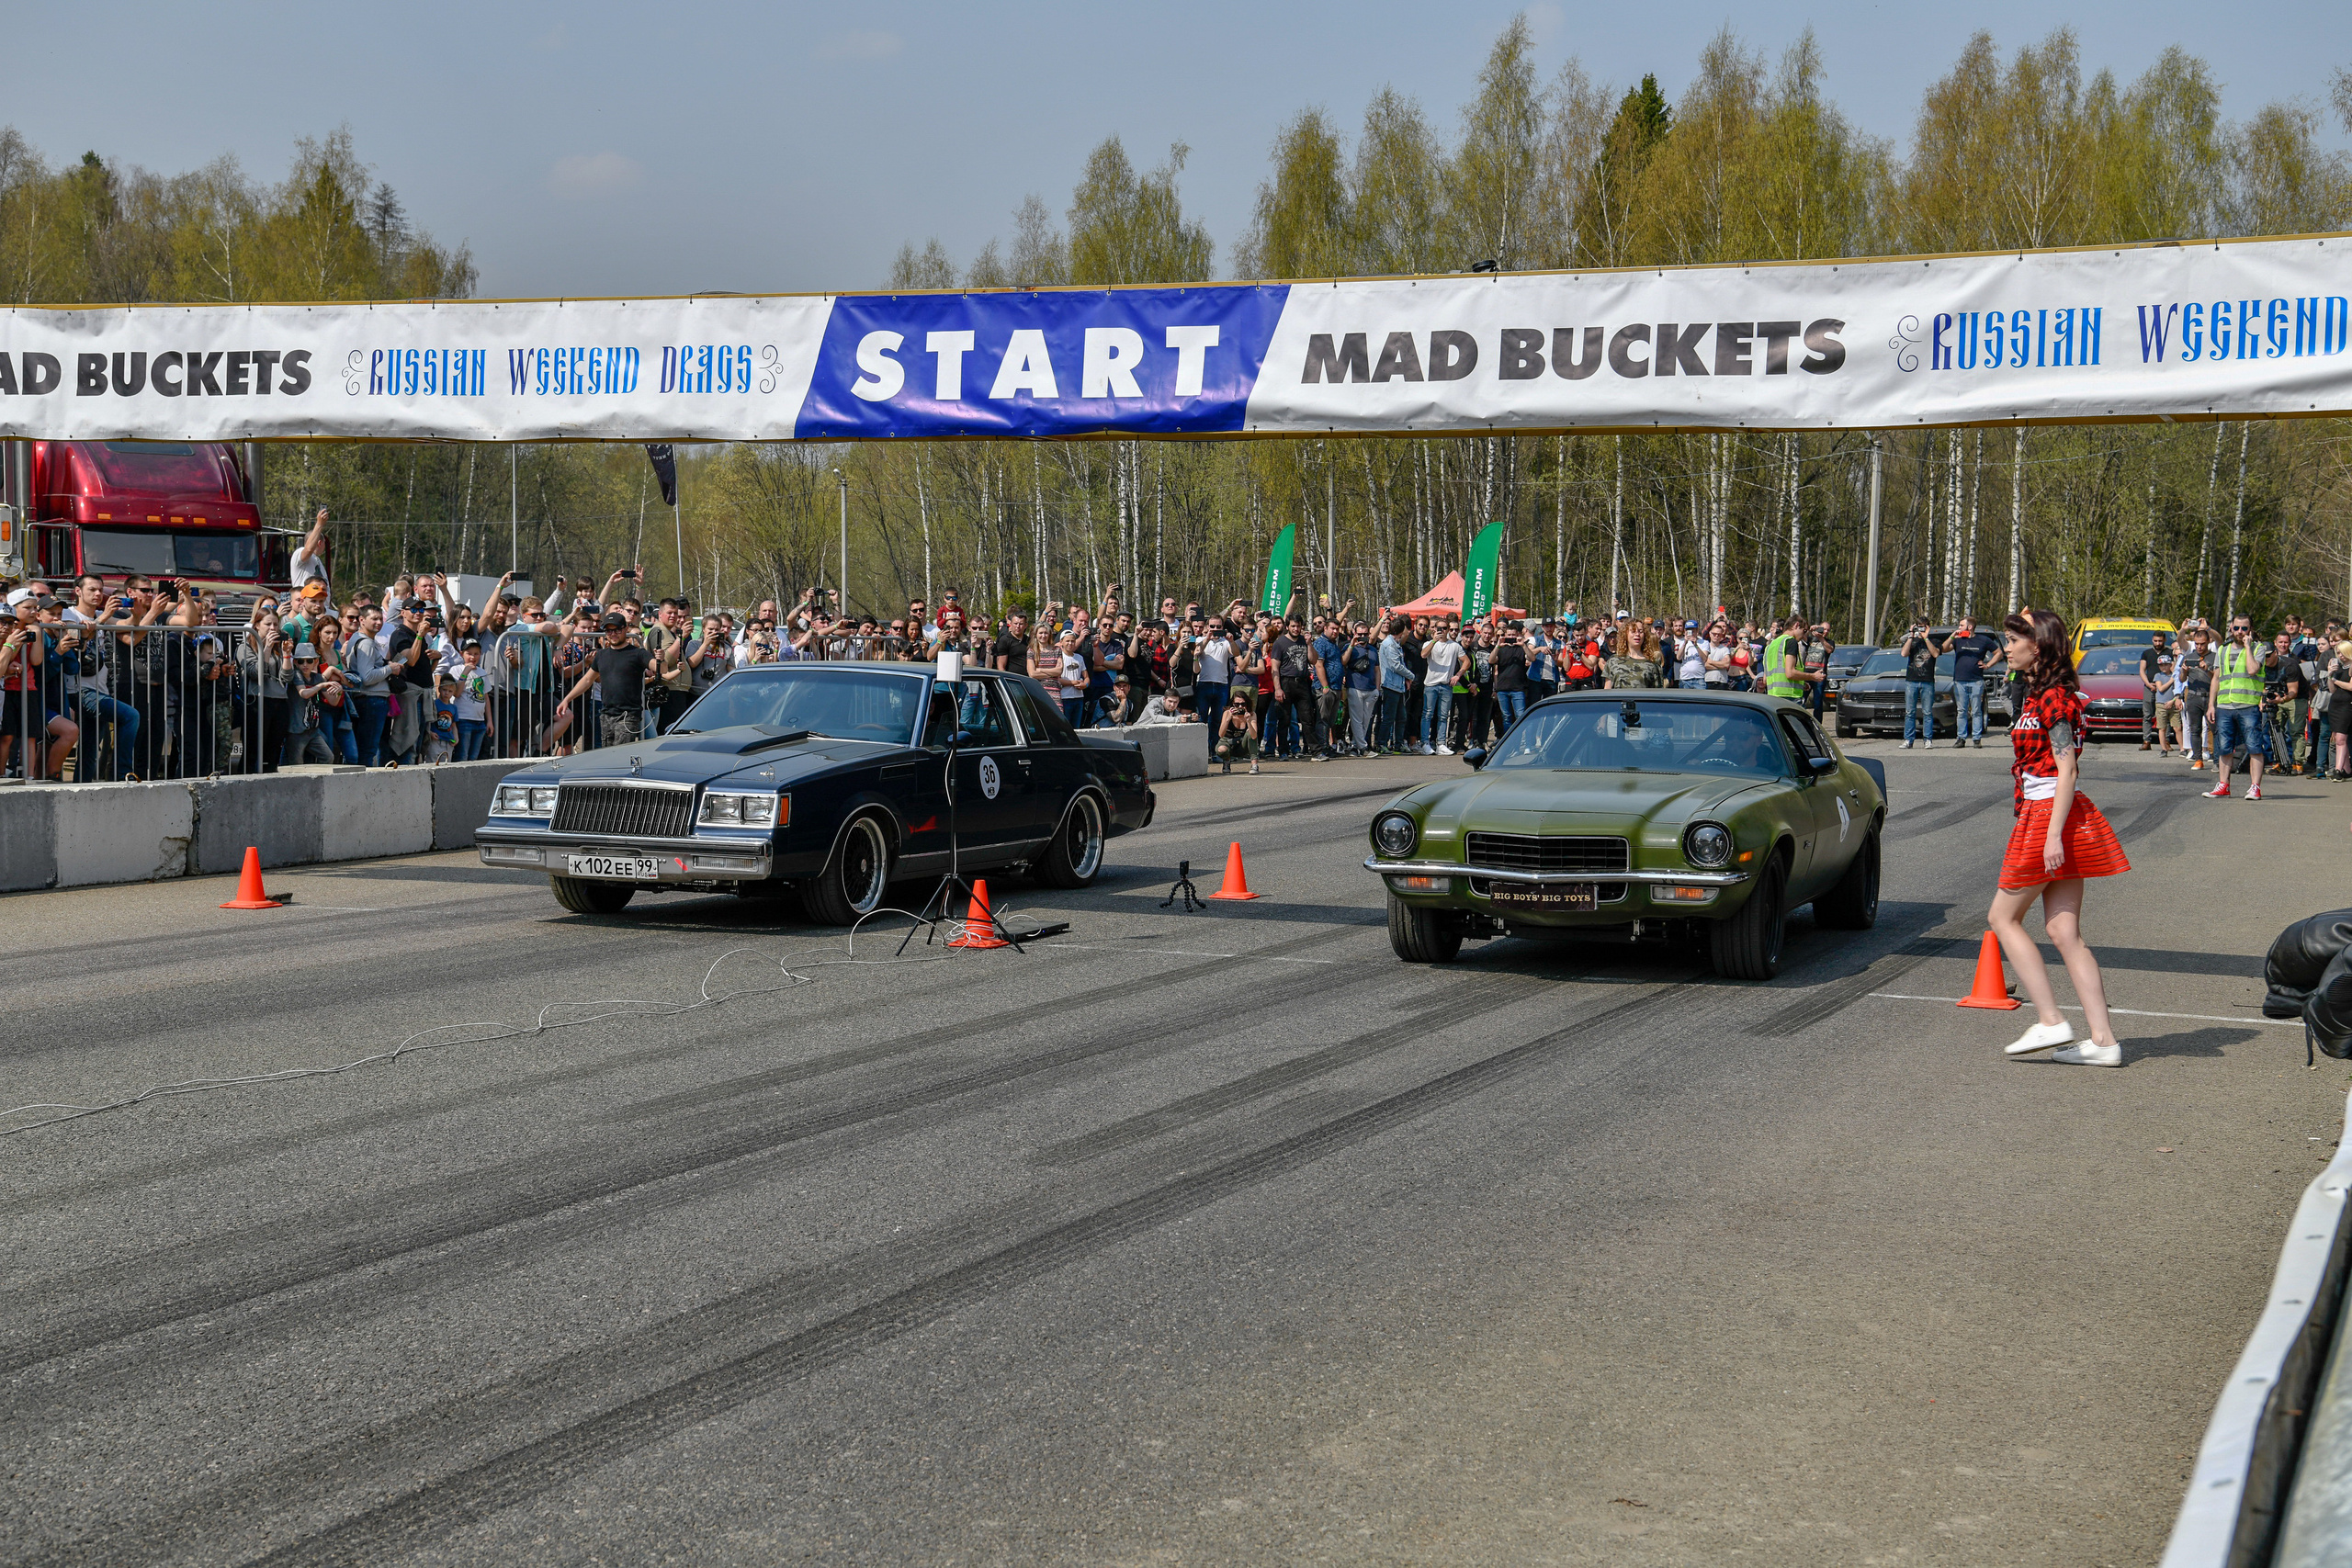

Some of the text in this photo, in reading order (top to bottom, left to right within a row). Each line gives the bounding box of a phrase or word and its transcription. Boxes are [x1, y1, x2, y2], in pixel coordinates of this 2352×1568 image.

[1301, 319, 1846, 384] MAD BUCKETS
[1931, 297, 2348, 371] RUSSIAN WEEKEND
[76, 350, 312, 397] BUCKETS
[369, 344, 753, 396] RUSSIAN WEEKEND DRAGS
[851, 325, 1220, 401] START
[1472, 568, 1483, 620] EEDOM
[983, 764, 996, 784] 36
[638, 859, 652, 873] 99
[1493, 892, 1510, 900] BIG
[1542, 894, 1562, 902] BIG
[1564, 894, 1591, 902] TOYS
